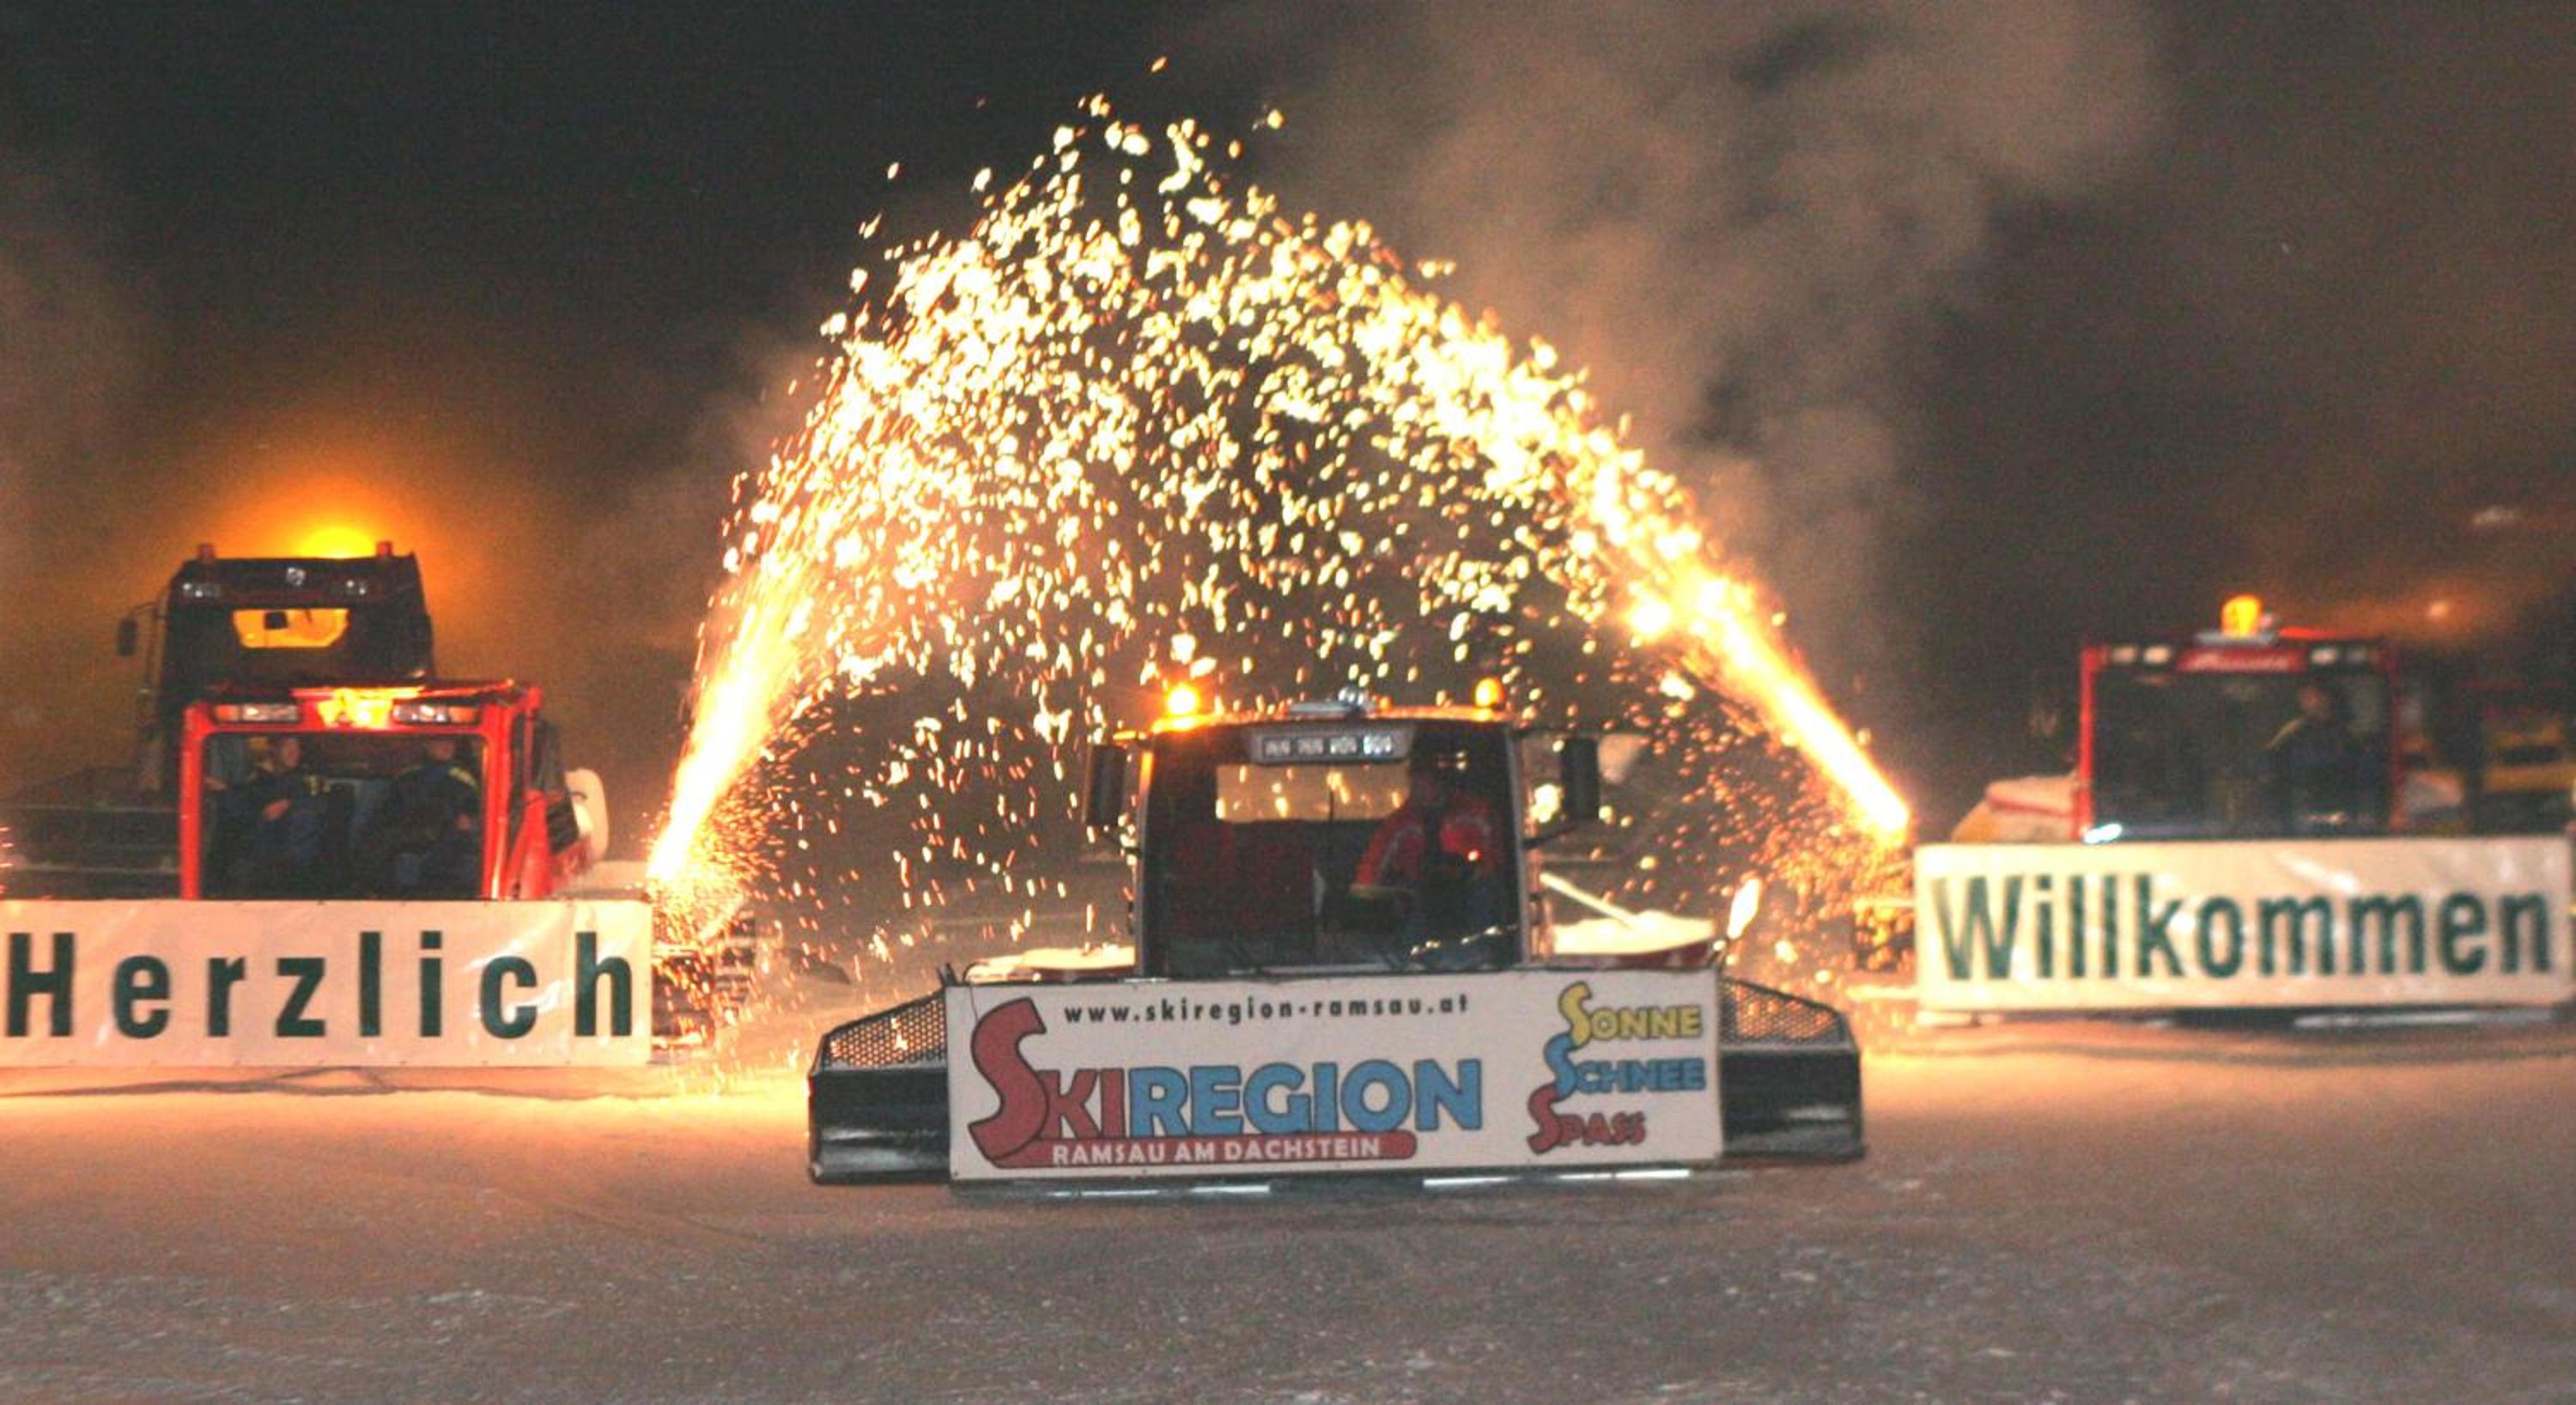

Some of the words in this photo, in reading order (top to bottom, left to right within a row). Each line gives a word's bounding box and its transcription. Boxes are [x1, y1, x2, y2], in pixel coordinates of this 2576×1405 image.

[1932, 873, 2552, 980] Willkommen
[7, 931, 634, 1038] Herzlich
[1064, 994, 1470, 1025] www.skiregion-ramsau.at
[1558, 981, 1703, 1051] SONNE
[969, 997, 1483, 1159] SKIREGION
[1544, 1032, 1705, 1099] SCHNEE
[1053, 1142, 1165, 1165] RAMSAU
[1174, 1140, 1216, 1163] AM
[1224, 1137, 1380, 1160] DACHSTEIN
[1527, 1084, 1646, 1154] SPASS
